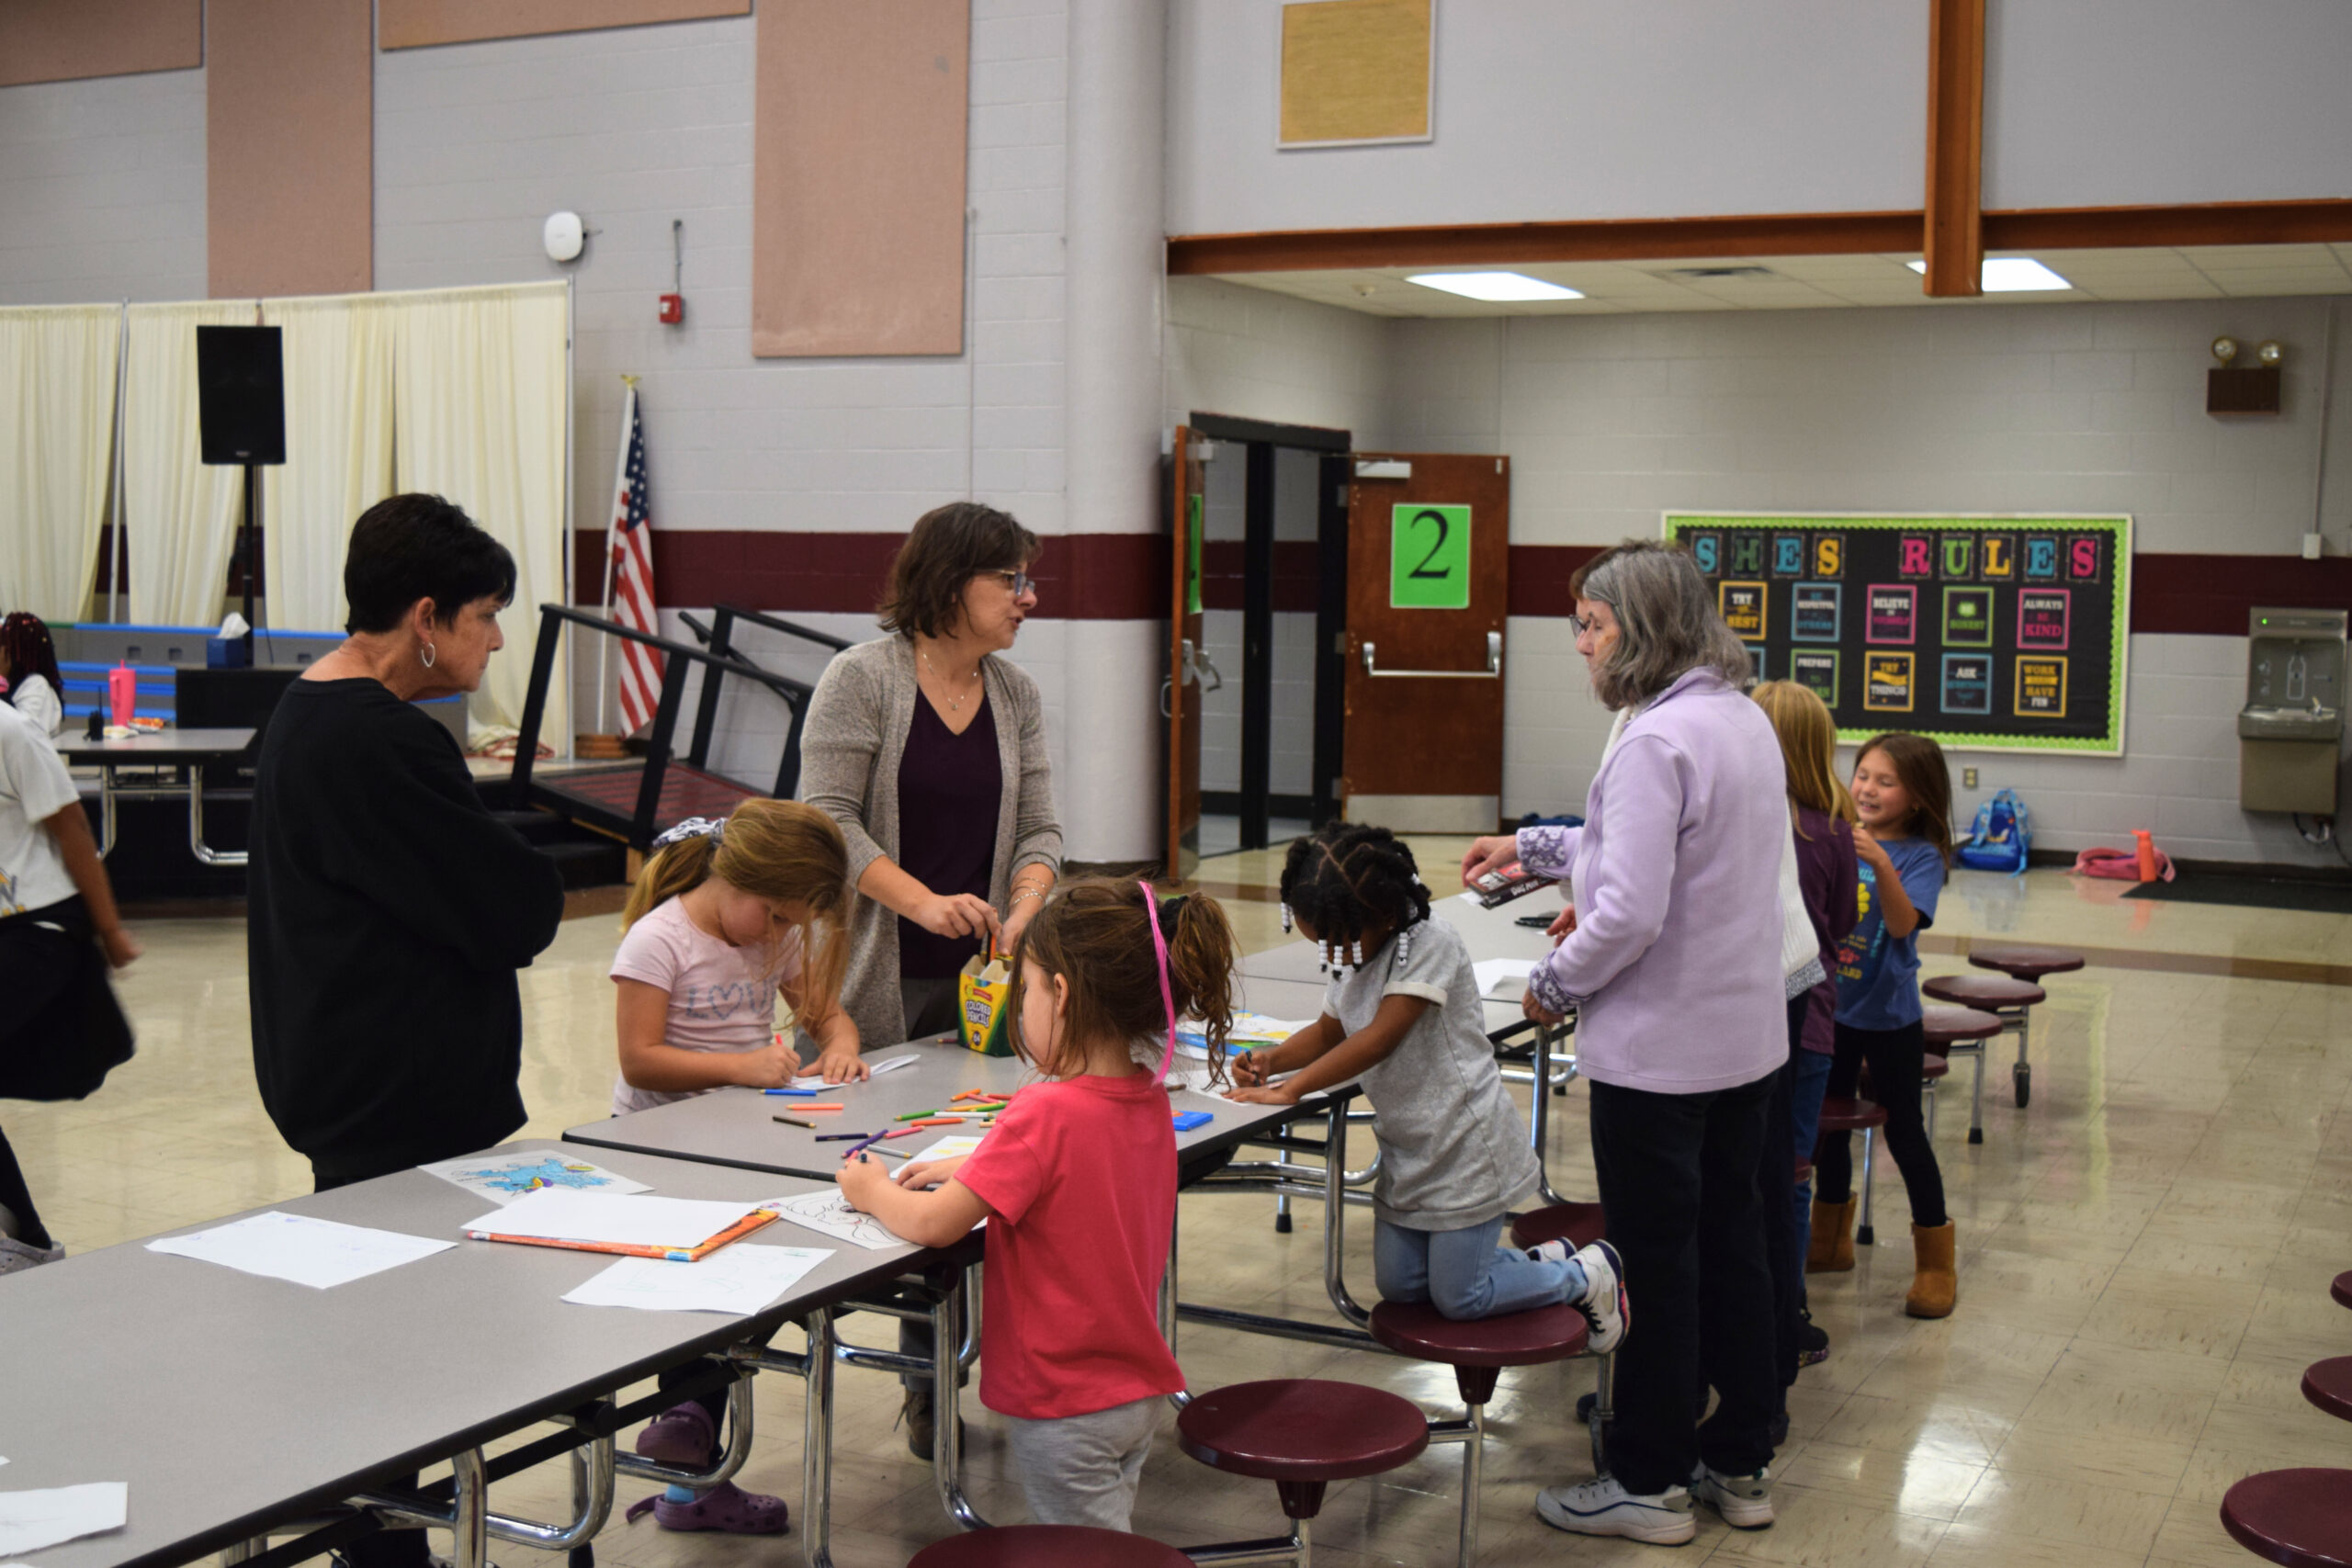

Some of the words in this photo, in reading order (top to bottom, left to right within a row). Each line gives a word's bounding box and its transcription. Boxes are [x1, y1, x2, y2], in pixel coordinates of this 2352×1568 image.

[1408, 510, 1451, 579] 2
[1695, 536, 1840, 576] SHES
[1901, 537, 2096, 578] RULES
[1732, 592, 1753, 605] TRY
[1872, 597, 1910, 609] BELIEVE
[2024, 599, 2064, 610] ALWAYS
[1726, 615, 1759, 628] BEST
[2024, 624, 2063, 637] KIND
[1797, 658, 1832, 668] PREPARE
[1955, 666, 1977, 679] ASK
[2023, 664, 2056, 675] WORK
[1870, 684, 1906, 695] THINGS
[2025, 686, 2056, 697] HAVE
[2030, 696, 2049, 707] FUN
